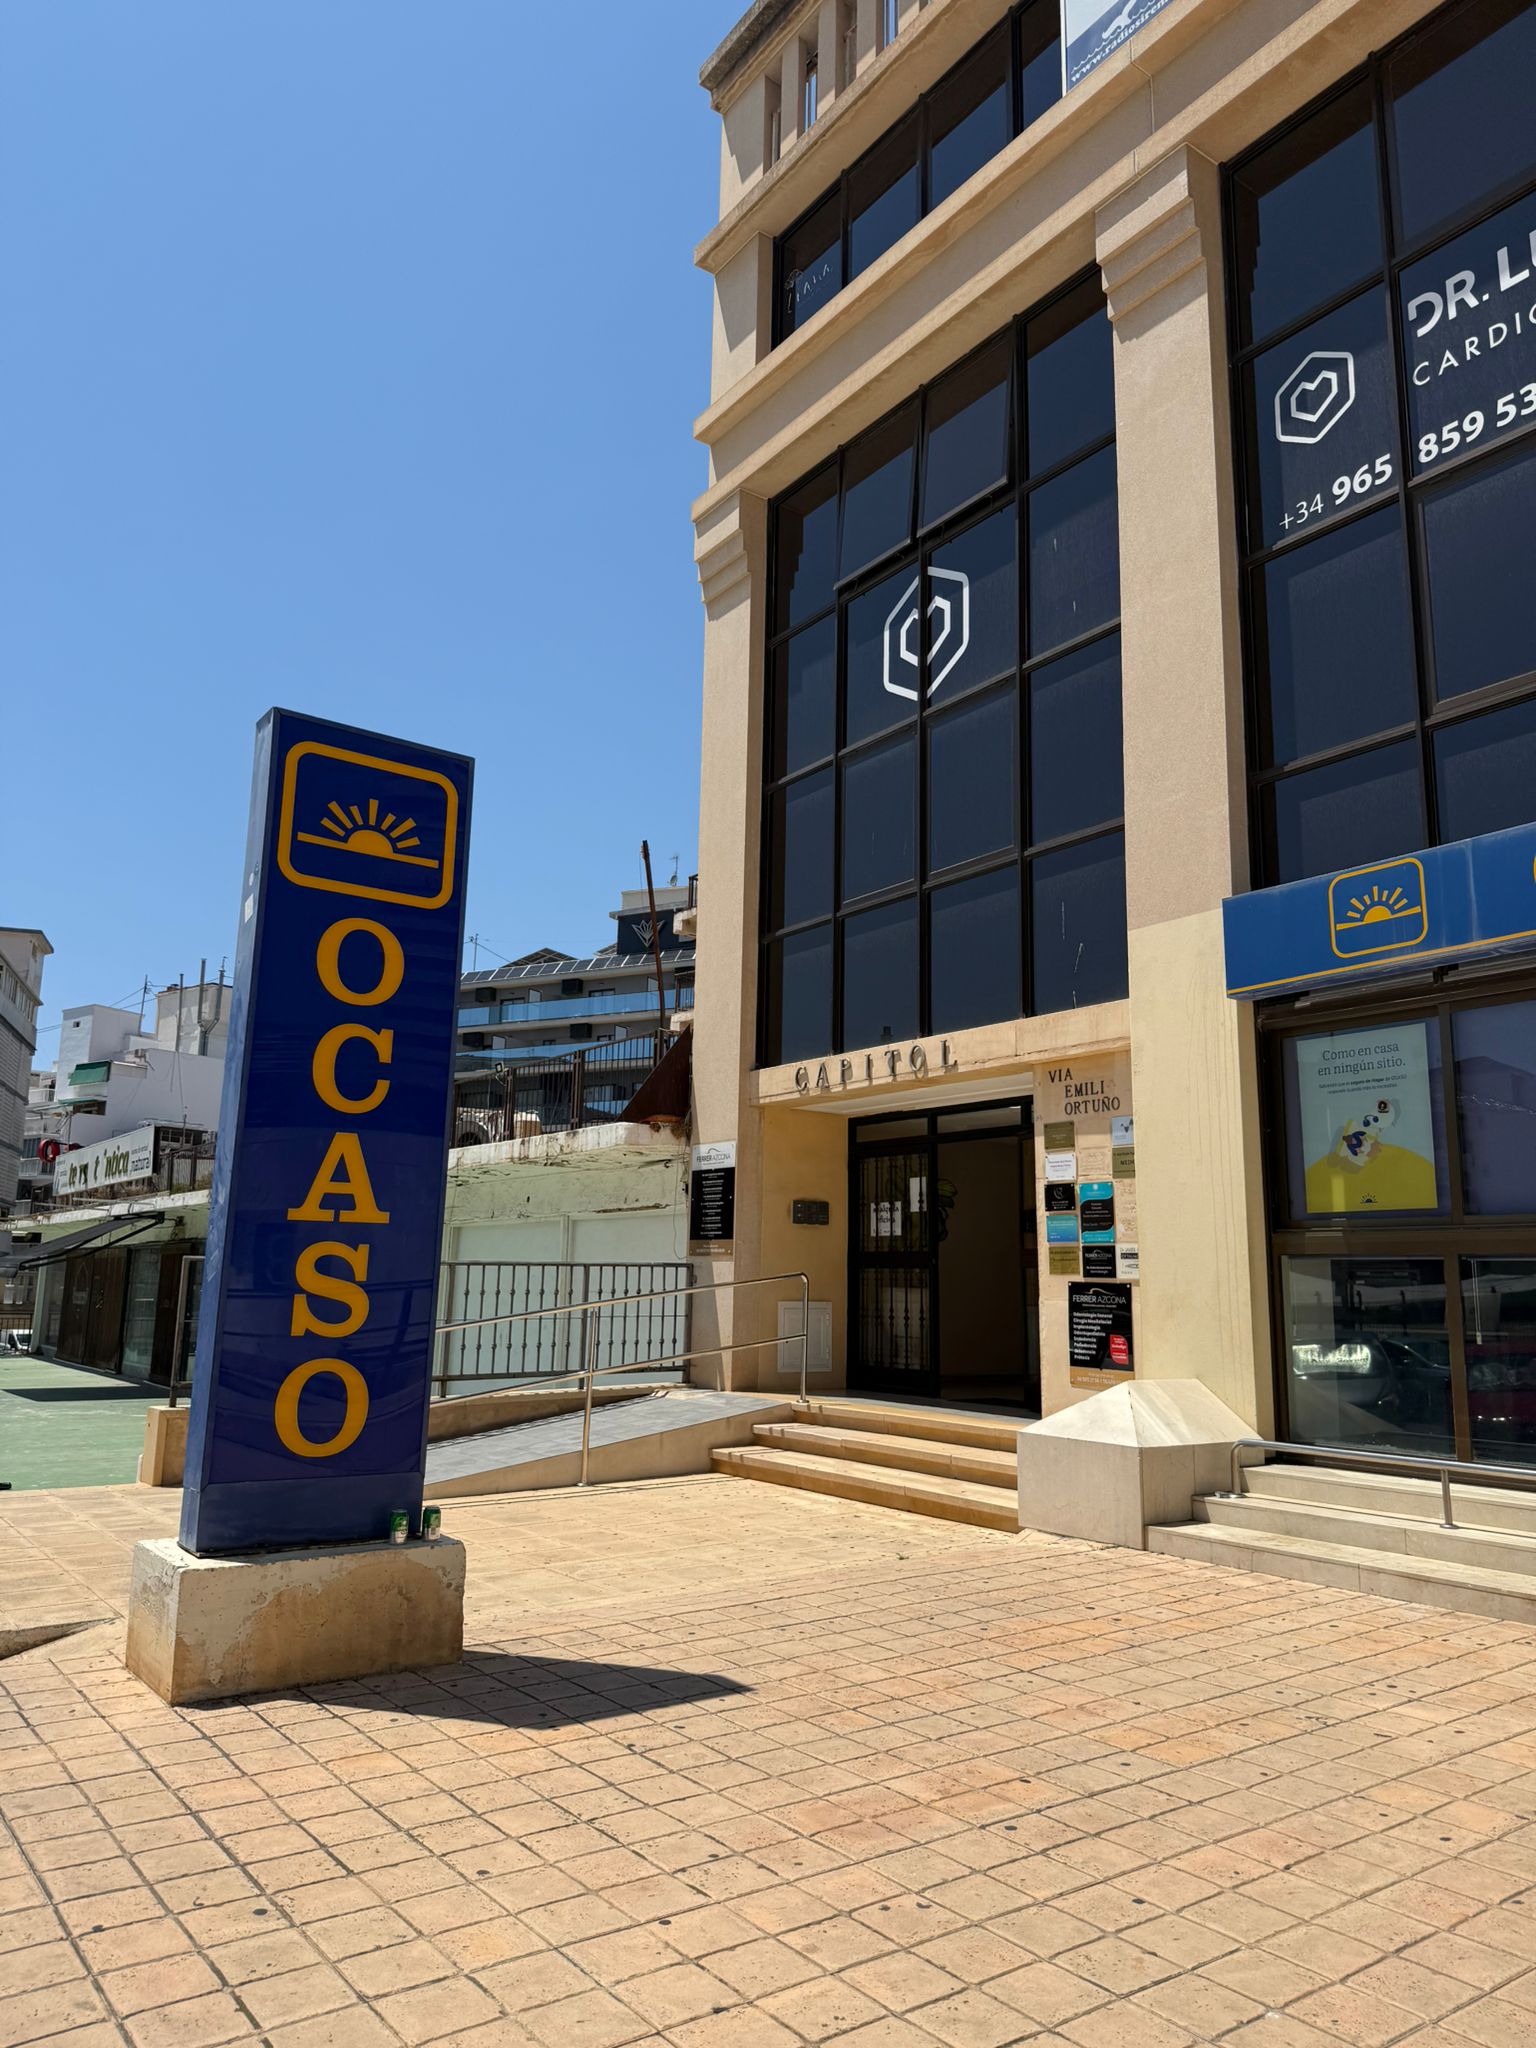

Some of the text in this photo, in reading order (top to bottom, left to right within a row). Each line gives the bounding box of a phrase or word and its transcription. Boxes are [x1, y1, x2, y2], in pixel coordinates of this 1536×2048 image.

[1407, 229, 1536, 338] DR. L
[1279, 493, 1324, 530] +34
[1332, 453, 1392, 506] 965
[1417, 410, 1485, 463] 859
[1322, 1042, 1399, 1061] Como en casa
[795, 1039, 958, 1092] CAPITOL
[1048, 1068, 1073, 1083] VIA
[1318, 1055, 1406, 1076] en ningún sitio.
[1065, 1081, 1105, 1098] EMILI
[1064, 1096, 1121, 1116] ORTUÑO
[274, 917, 404, 1459] OCASO
[1072, 1294, 1127, 1304] FERRER AZCONA
